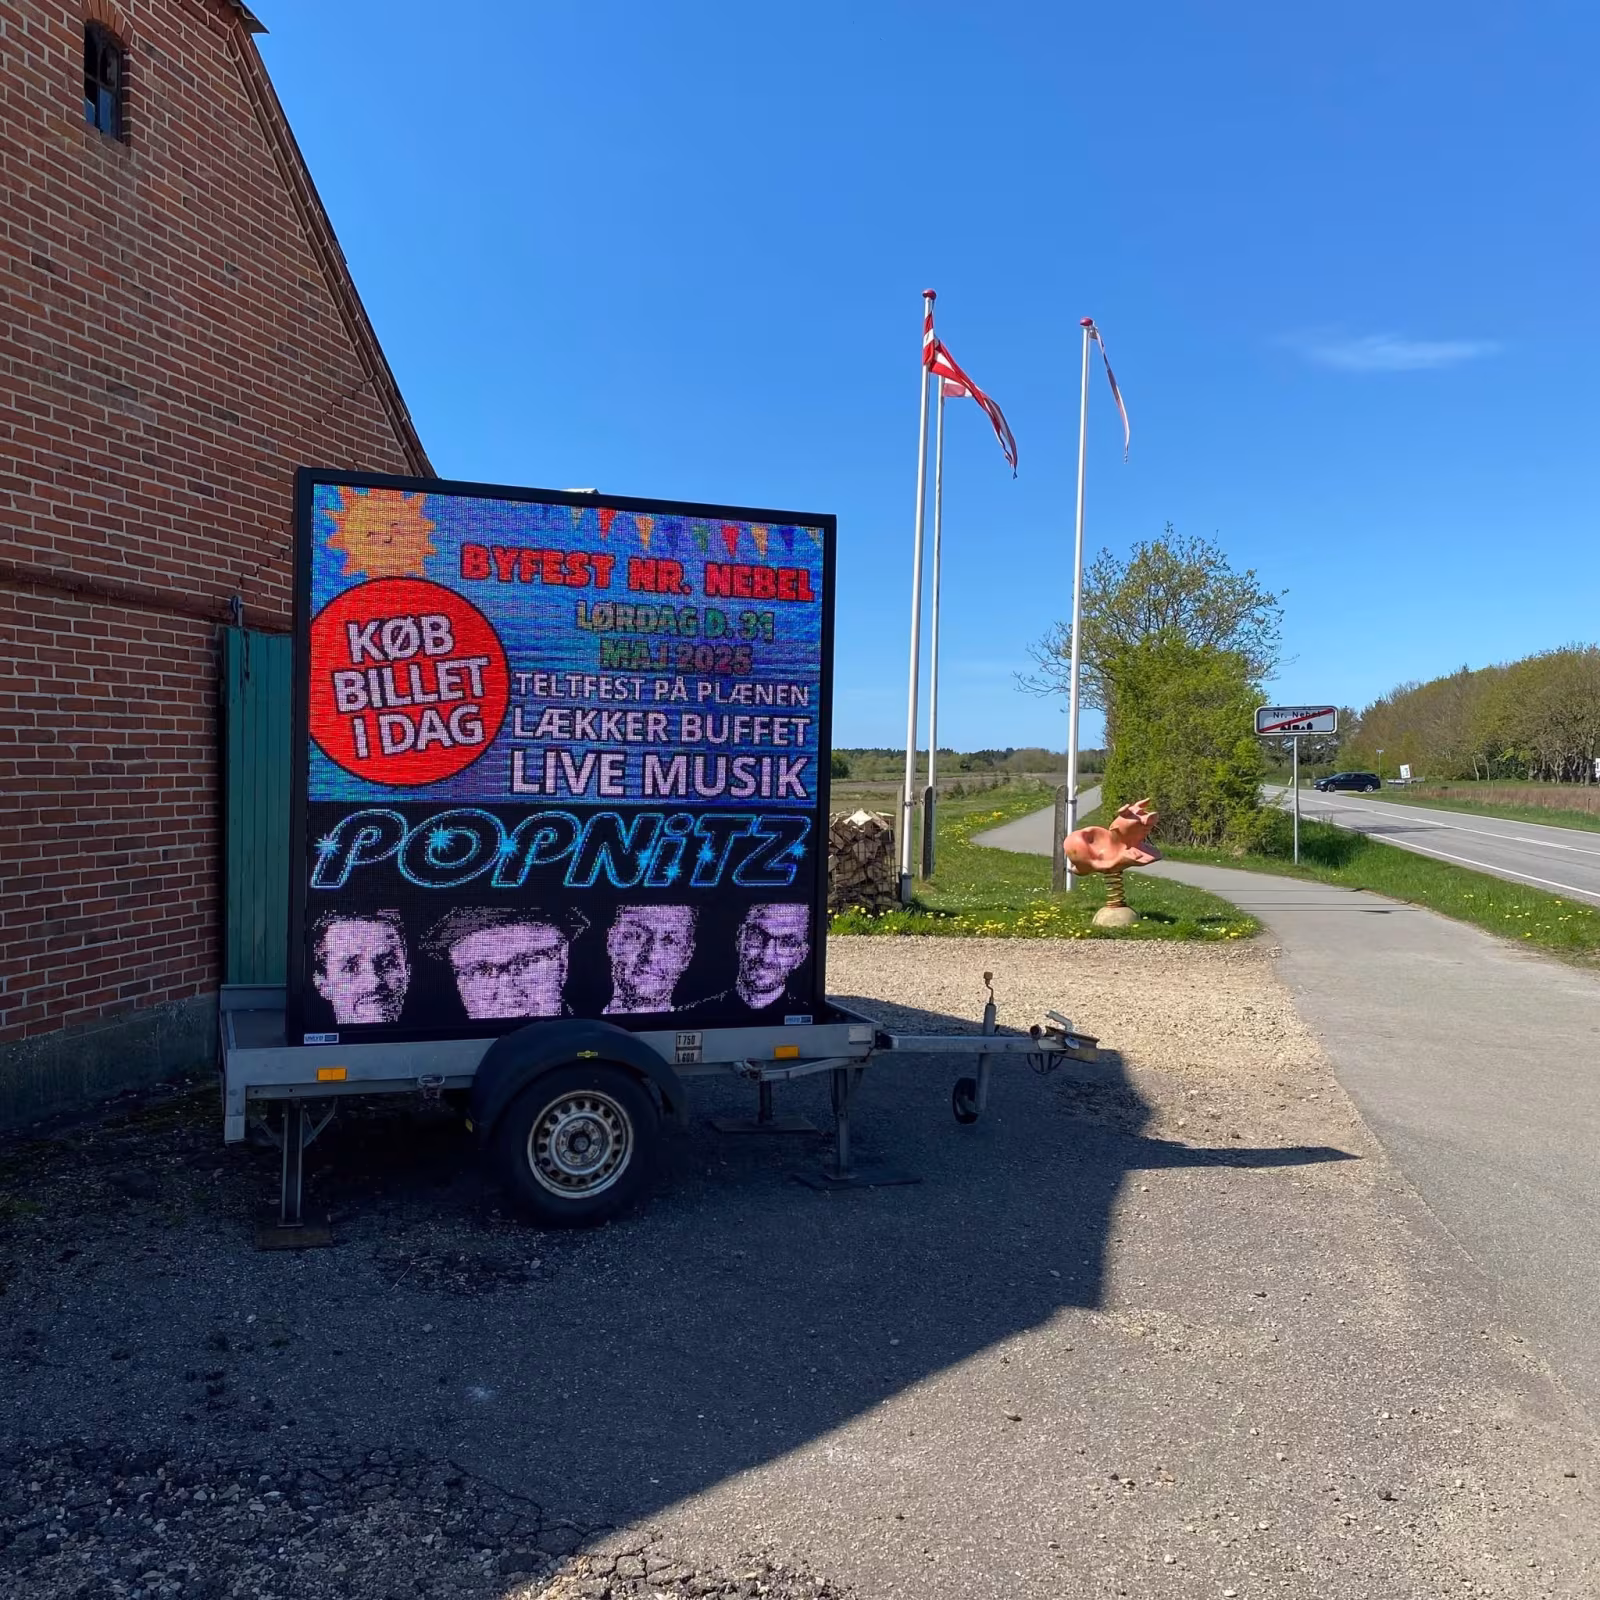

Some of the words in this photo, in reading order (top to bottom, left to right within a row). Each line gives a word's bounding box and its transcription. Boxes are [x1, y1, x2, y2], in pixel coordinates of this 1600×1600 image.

[461, 544, 615, 590] BYFEST
[628, 556, 692, 595] NR.
[704, 561, 815, 602] NEBEL
[347, 615, 454, 663] KØB
[576, 600, 697, 637] LØRDAG
[704, 608, 734, 640] D.
[738, 610, 775, 642] 31
[601, 638, 669, 672] MAJ
[675, 642, 753, 674] 2025
[333, 656, 489, 712] BILLET
[515, 673, 645, 700] TELTFEST
[654, 675, 689, 701] PÅ
[697, 681, 809, 706] PLÆNEN
[353, 717, 369, 758] I
[379, 704, 484, 755] DAG
[513, 707, 669, 742] LÆKKER
[681, 713, 811, 747] BUFFET
[1273, 711, 1287, 719] Nr.
[513, 750, 625, 795] LIVE
[643, 754, 808, 797] MUSIK
[683, 1035, 696, 1045] 750
